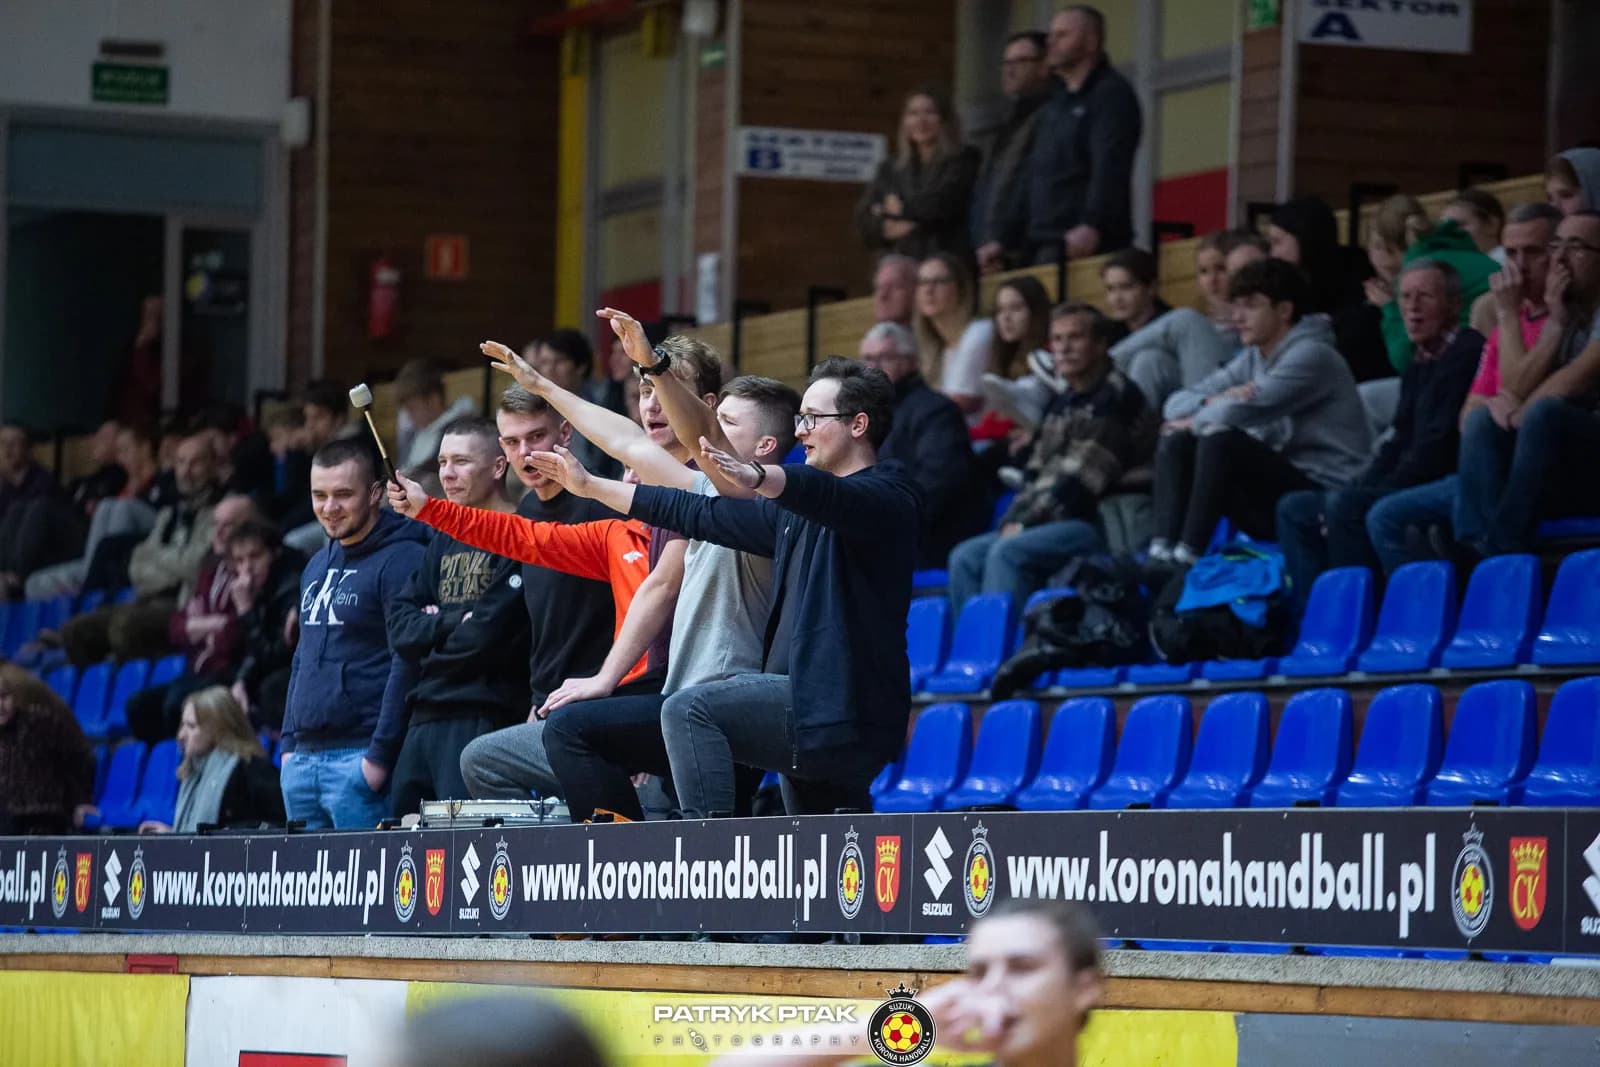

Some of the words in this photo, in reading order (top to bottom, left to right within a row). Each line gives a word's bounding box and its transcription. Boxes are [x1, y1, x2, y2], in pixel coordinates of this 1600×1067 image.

[1310, 12, 1363, 40] A
[152, 848, 386, 925] www.koronahandball.pl
[427, 875, 441, 908] CK
[521, 834, 828, 922] www.koronahandball.pl
[876, 866, 895, 903] CK
[1006, 830, 1436, 938] www.koronahandball.pl
[1512, 873, 1540, 919] CK
[458, 907, 480, 919] SUZUKI
[922, 902, 952, 916] SUZUKI
